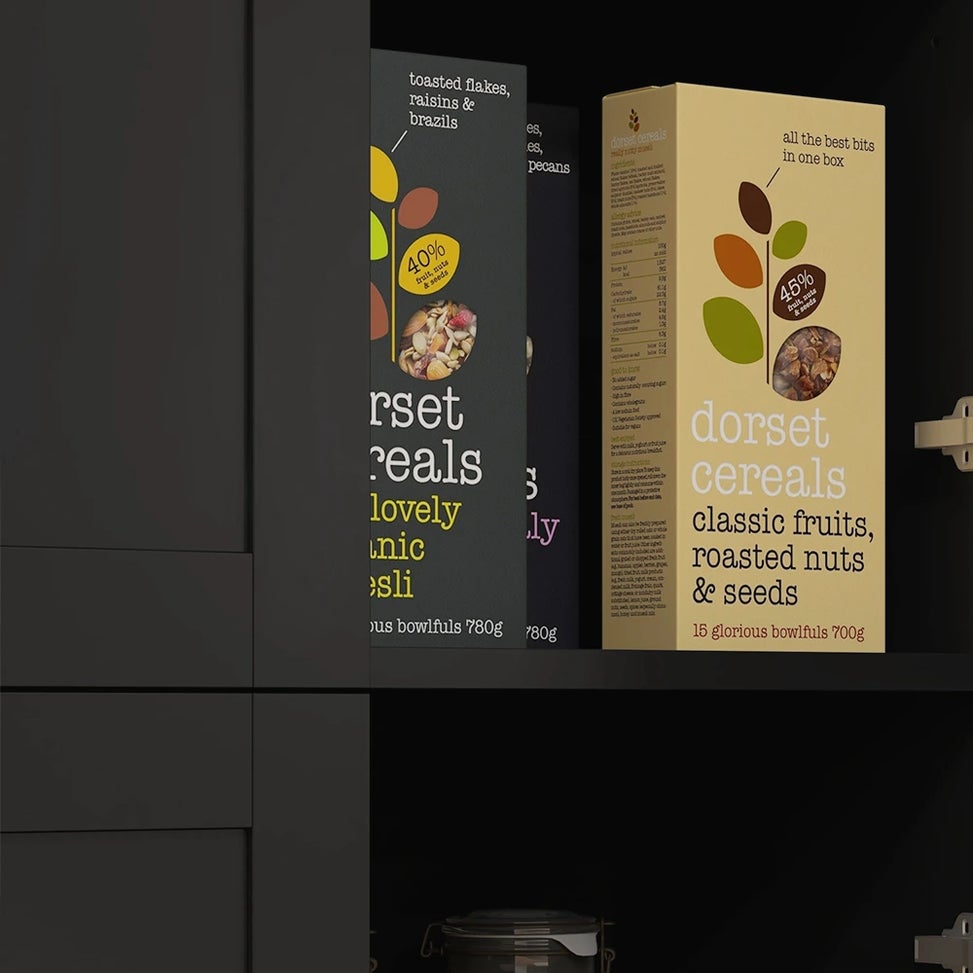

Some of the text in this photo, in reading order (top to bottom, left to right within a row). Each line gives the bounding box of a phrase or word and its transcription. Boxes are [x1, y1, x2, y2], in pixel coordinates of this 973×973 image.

[409, 72, 511, 98] toasted flakes,
[409, 93, 475, 112] raisins &
[409, 112, 458, 129] brazils
[526, 142, 543, 155] es,
[783, 131, 875, 152] all the best bits
[528, 160, 571, 174] pecans
[783, 149, 845, 167] in one box
[408, 240, 446, 275] 40%
[434, 260, 449, 273] nuts
[431, 270, 449, 286] seeds
[780, 269, 814, 303] 45%
[800, 297, 817, 313] seeds
[803, 288, 817, 301] nuts
[370, 386, 464, 431] rset
[690, 400, 830, 448] dorset
[691, 456, 847, 500] cereals
[370, 493, 462, 531] lovely
[526, 511, 560, 546] ly
[692, 506, 875, 543] classic fruits,
[692, 544, 865, 572] roasted nuts
[692, 576, 798, 606] & seeds
[396, 618, 462, 635] bowlfuls
[466, 619, 504, 637] 780g
[692, 623, 865, 642] 15 glorious bowlfuls 700g
